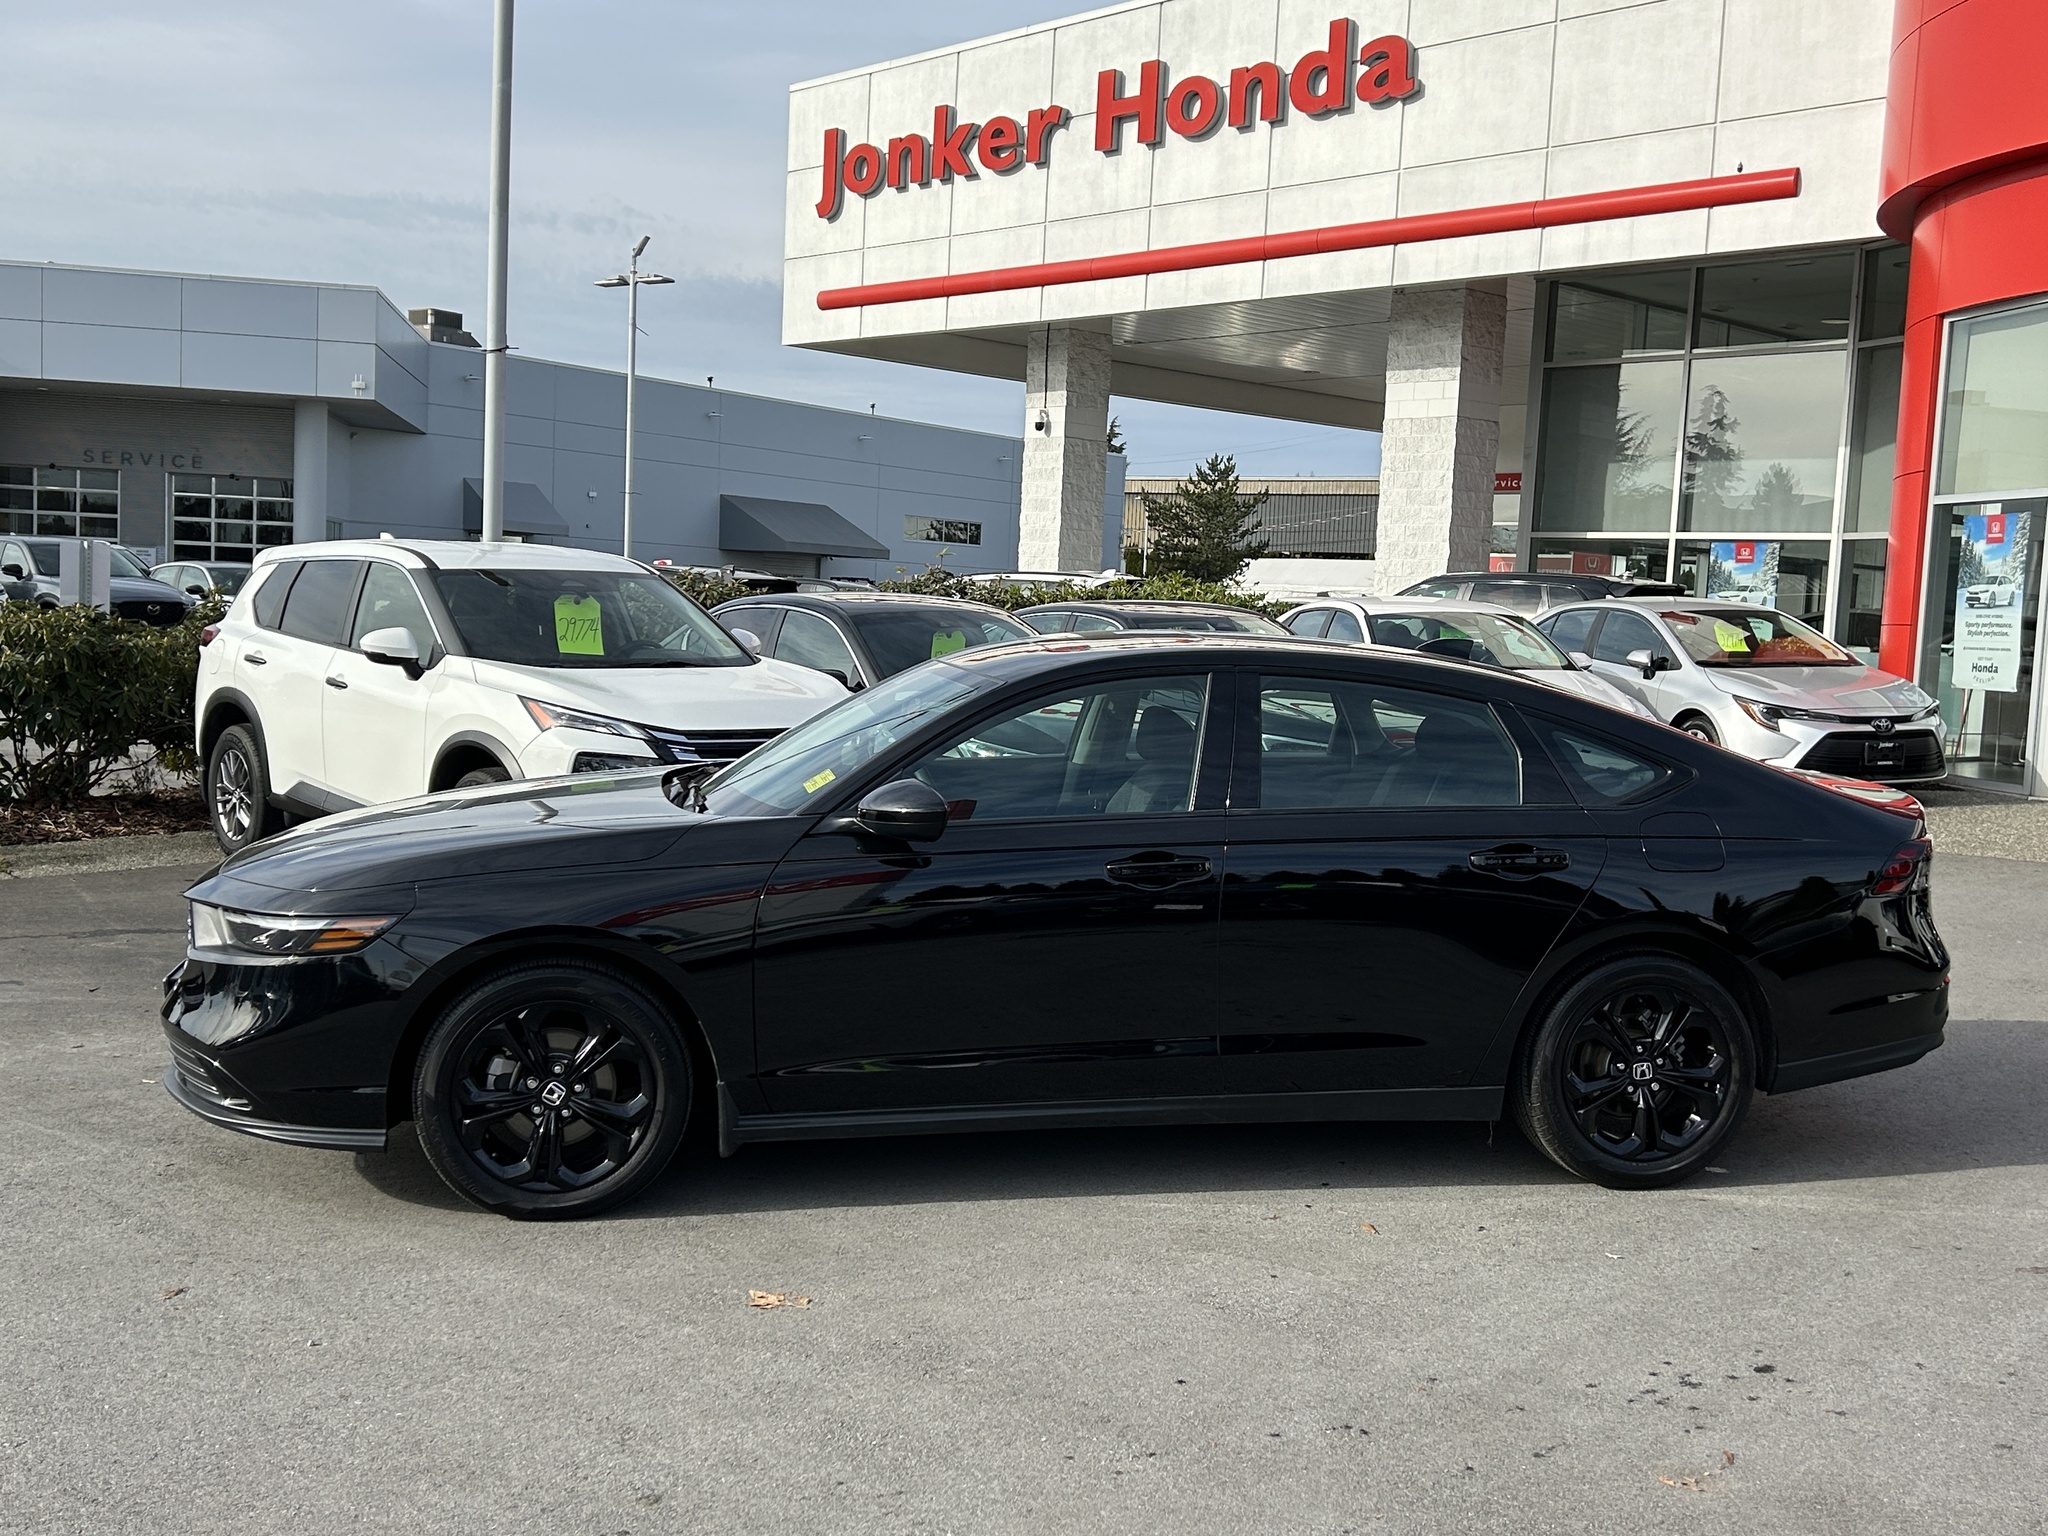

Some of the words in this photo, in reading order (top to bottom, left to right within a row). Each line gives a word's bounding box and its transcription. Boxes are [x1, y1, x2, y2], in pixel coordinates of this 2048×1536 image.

[815, 102, 1069, 220] Jonker
[1094, 17, 1422, 156] Honda
[83, 449, 203, 469] SERVICE
[1965, 621, 1980, 629] Sporty
[1981, 621, 2013, 629] performance.
[1967, 629, 1983, 637] Stylish
[1983, 630, 2010, 638] perfection.
[1971, 662, 1999, 674] Honda
